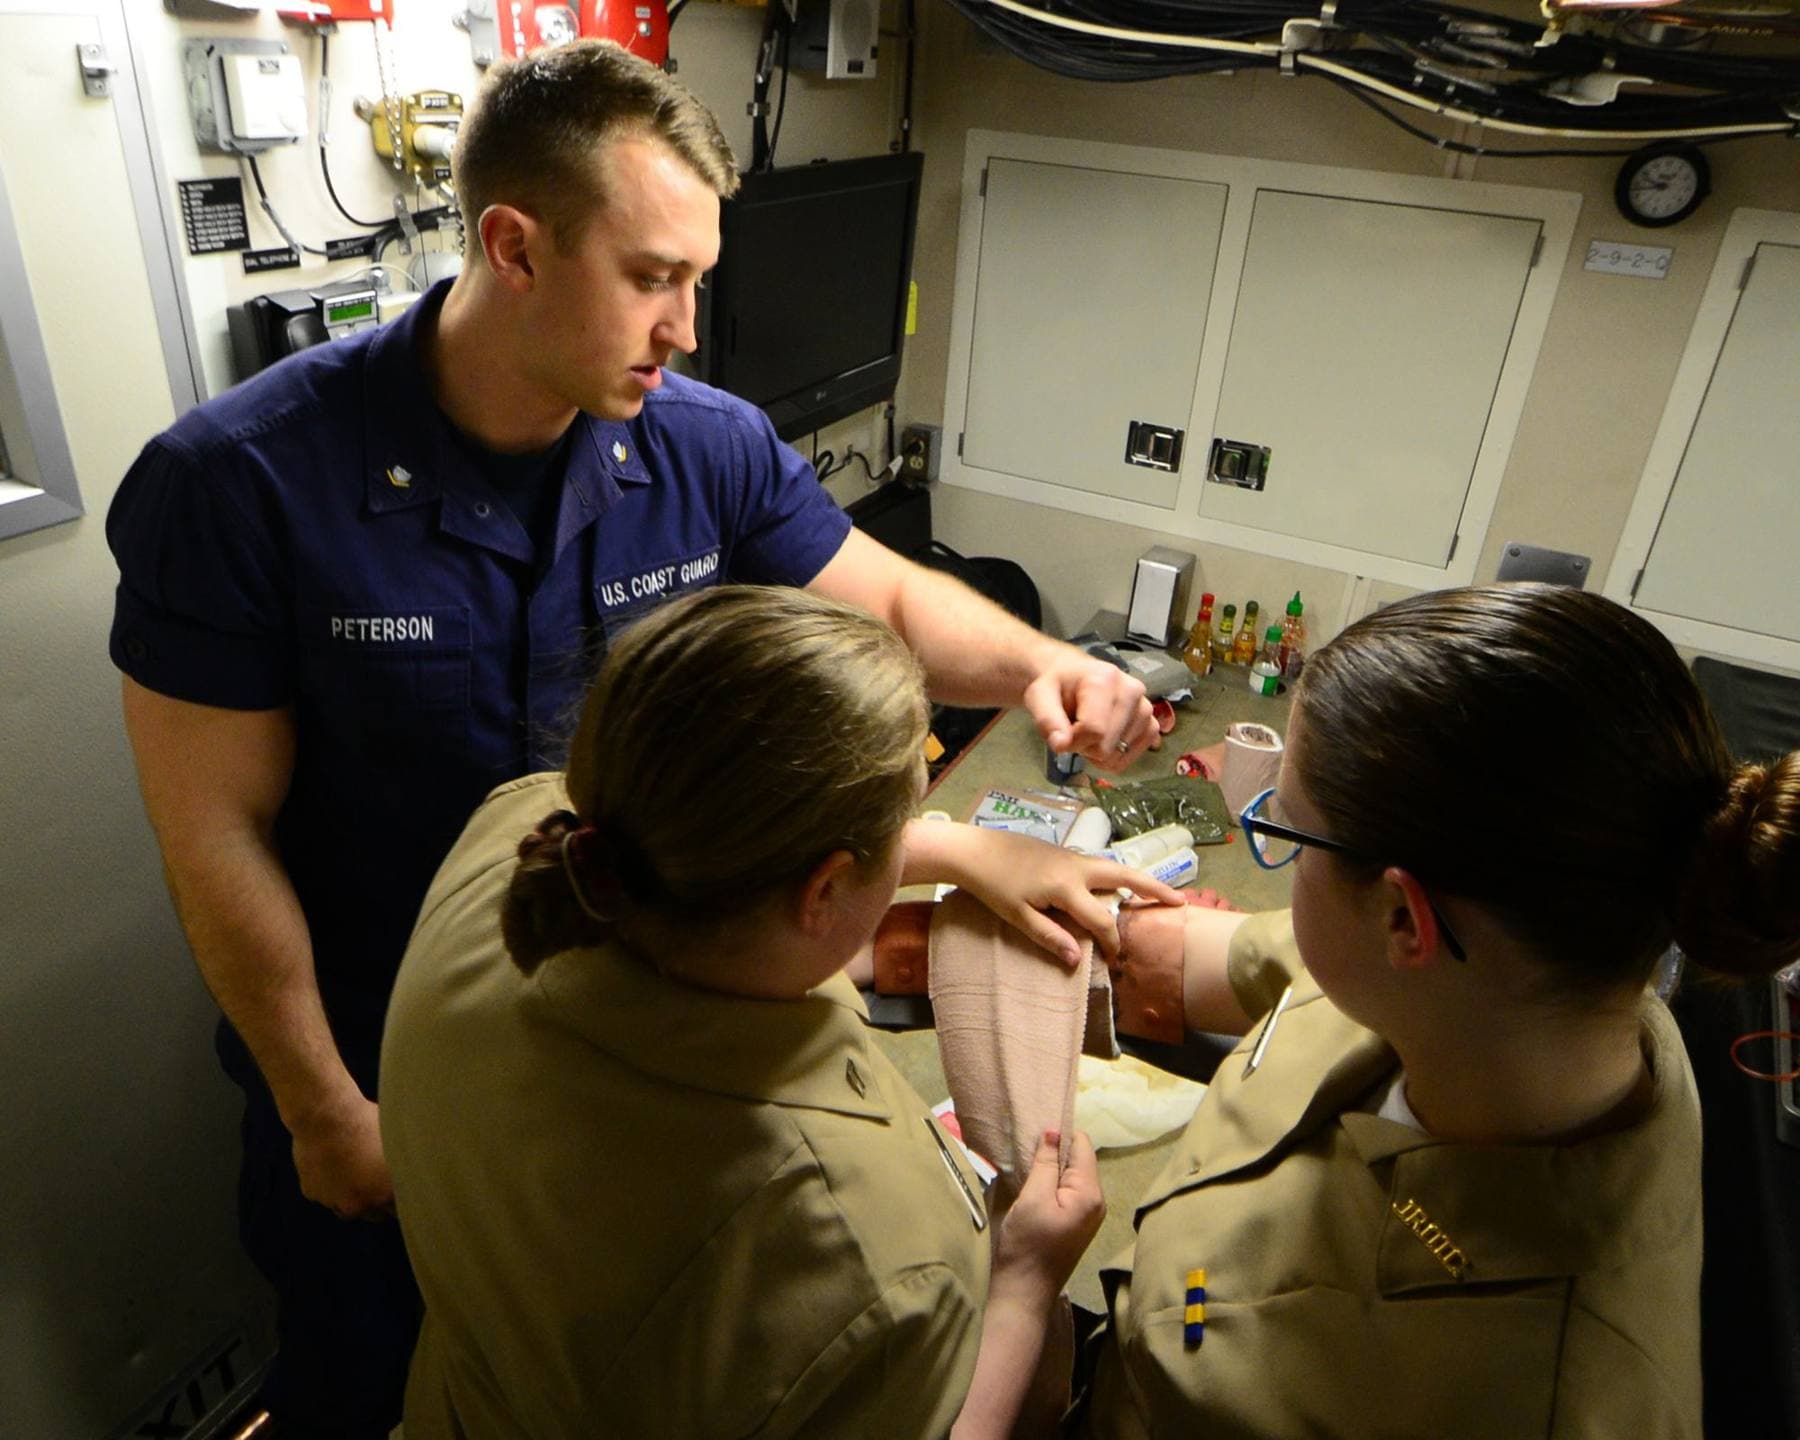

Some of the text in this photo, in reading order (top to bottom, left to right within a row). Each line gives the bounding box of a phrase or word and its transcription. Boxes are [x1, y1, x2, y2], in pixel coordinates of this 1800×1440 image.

[601, 552, 719, 607] U.S. COAST GUARD
[332, 616, 434, 642] PETERSON
[135, 1336, 242, 1440] XIT
